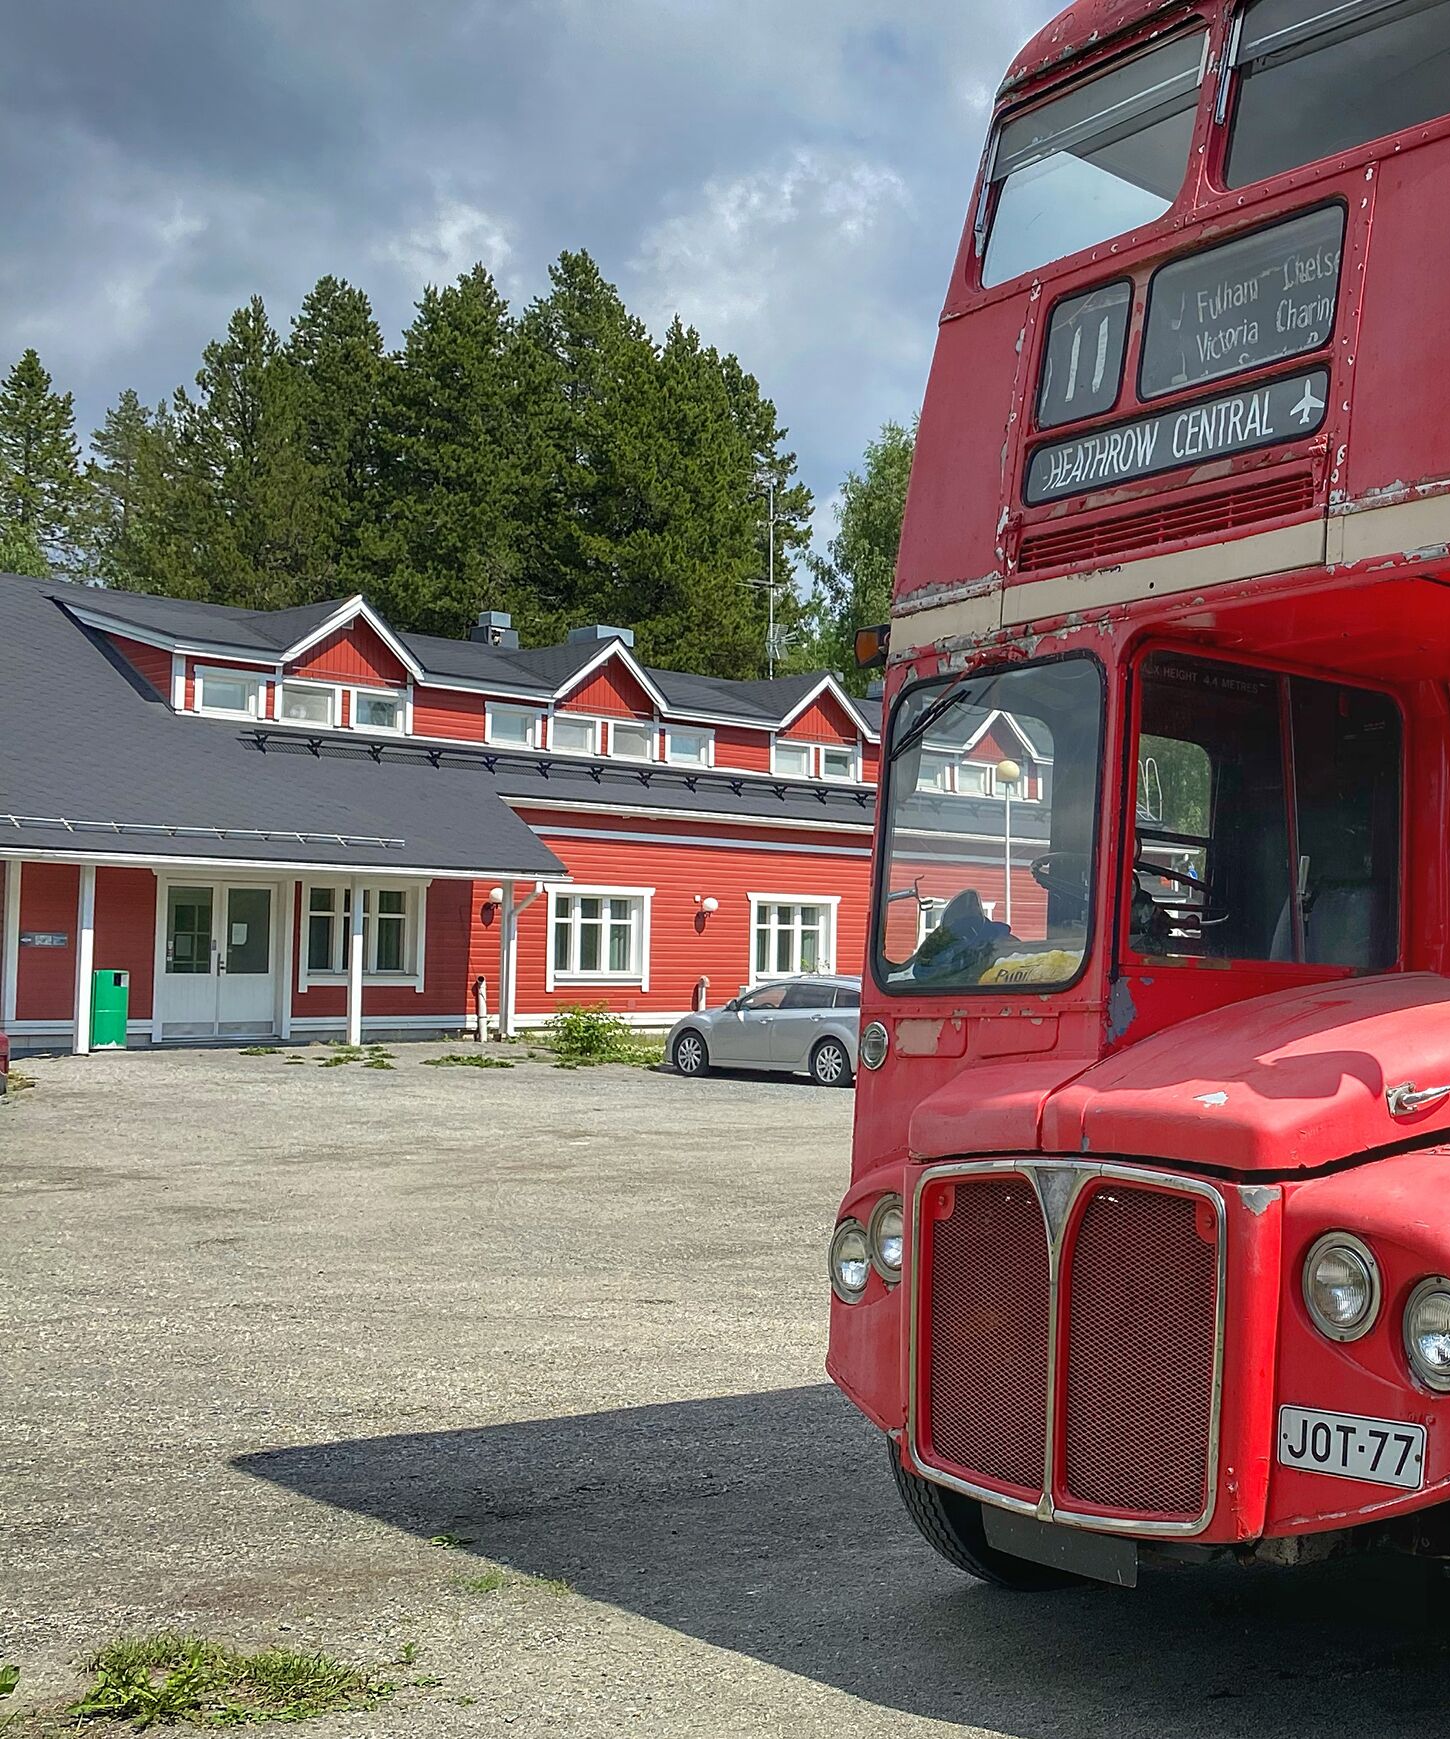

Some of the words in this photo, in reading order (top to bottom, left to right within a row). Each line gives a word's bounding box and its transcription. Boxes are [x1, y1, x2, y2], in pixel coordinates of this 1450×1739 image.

[1197, 279, 1258, 323] Fulham
[1065, 317, 1108, 402] 11
[1196, 319, 1258, 363] Victoria
[1043, 421, 1160, 491] HEATHROW
[1172, 391, 1273, 458] CENTRAL
[1163, 667, 1198, 682] HEIGHT
[1221, 678, 1259, 694] METRES
[1287, 1419, 1415, 1476] JOT-77
